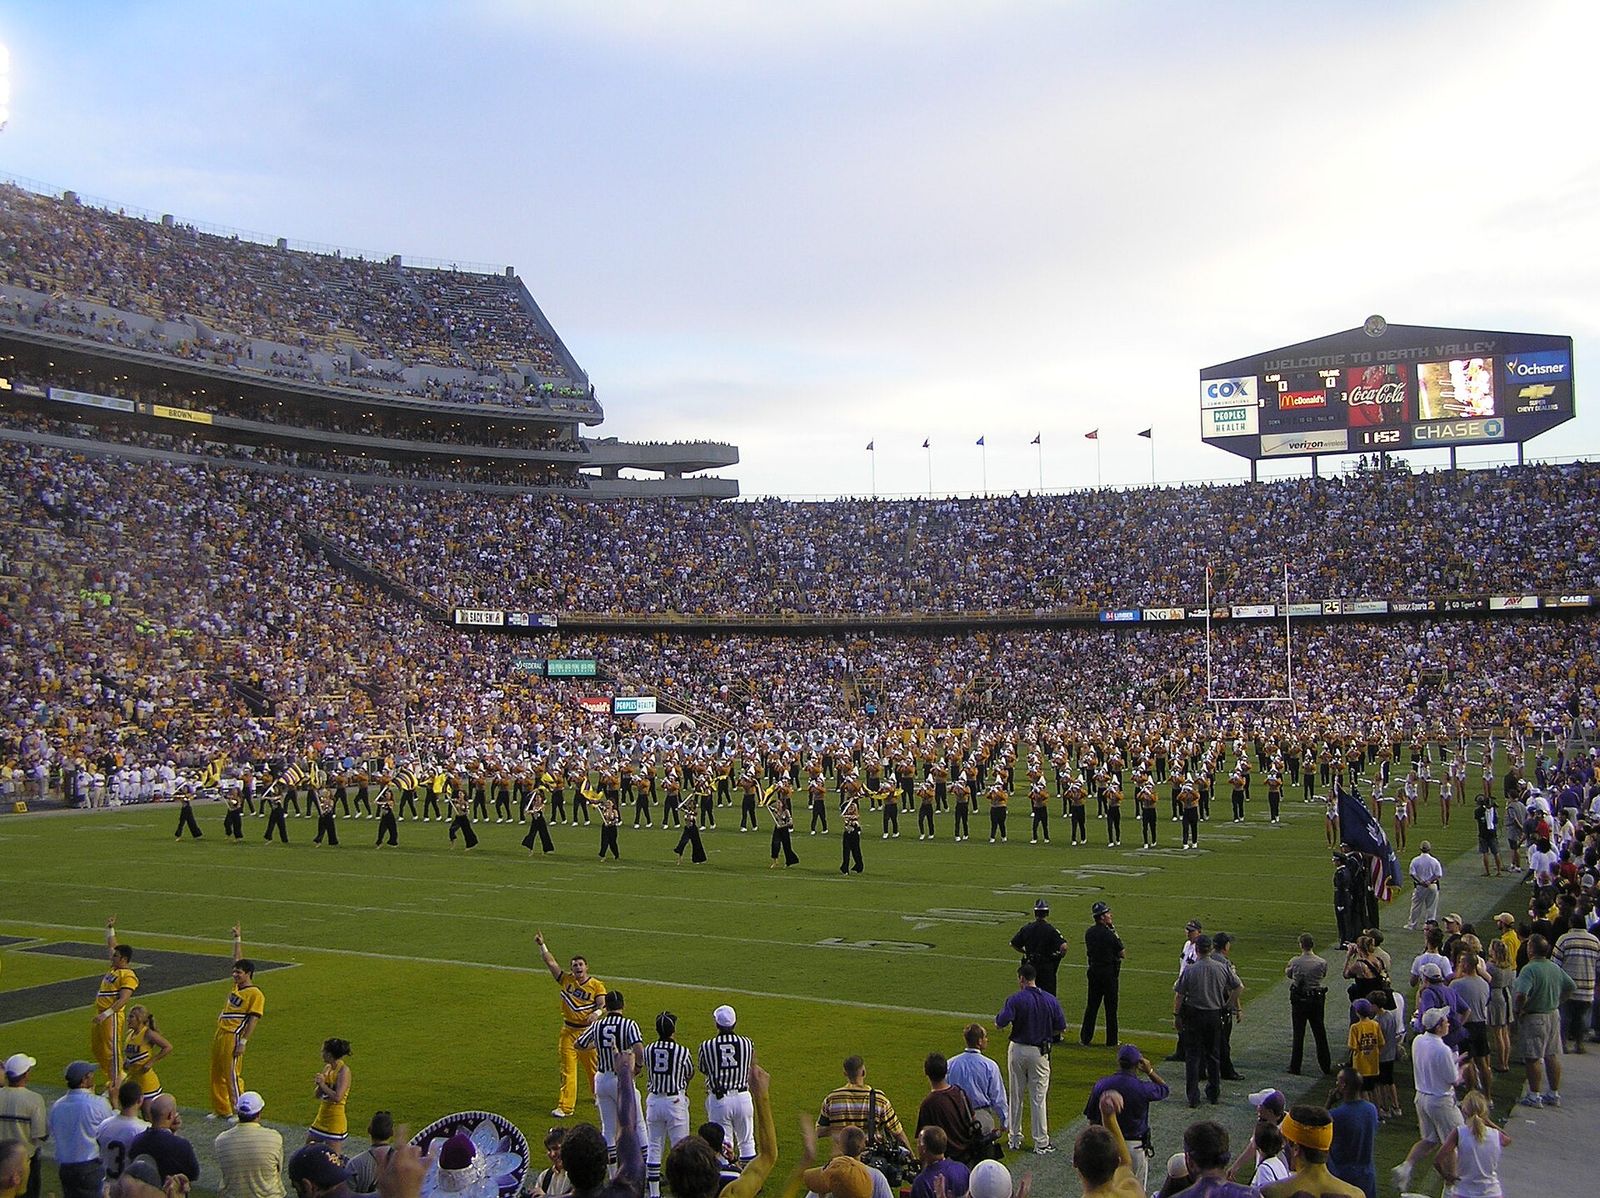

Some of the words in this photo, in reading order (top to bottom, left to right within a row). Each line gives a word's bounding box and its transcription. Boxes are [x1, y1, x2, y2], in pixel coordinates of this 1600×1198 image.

[1264, 354, 1345, 371] WELCOME
[1351, 351, 1371, 363] TO
[1377, 348, 1430, 361] DEATH
[1434, 341, 1496, 356] VALLEY
[1517, 363, 1564, 376] Ochsner
[1207, 380, 1248, 399] COX
[1281, 394, 1325, 407] McDonald's
[168, 408, 193, 420] BROWN
[1215, 410, 1245, 421] PEOPLES
[1216, 422, 1246, 433] HEALTH
[1415, 422, 1481, 440] CHASE
[1289, 440, 1324, 451] verizon
[1324, 601, 1340, 613] 25
[1428, 601, 1436, 610] 2
[1144, 610, 1167, 620] ING
[616, 700, 637, 710] PEOPLES
[567, 984, 591, 1001] LSU
[602, 1025, 618, 1048] S
[654, 1049, 669, 1073] B
[719, 1043, 738, 1068] R
[107, 1140, 126, 1179] 3
